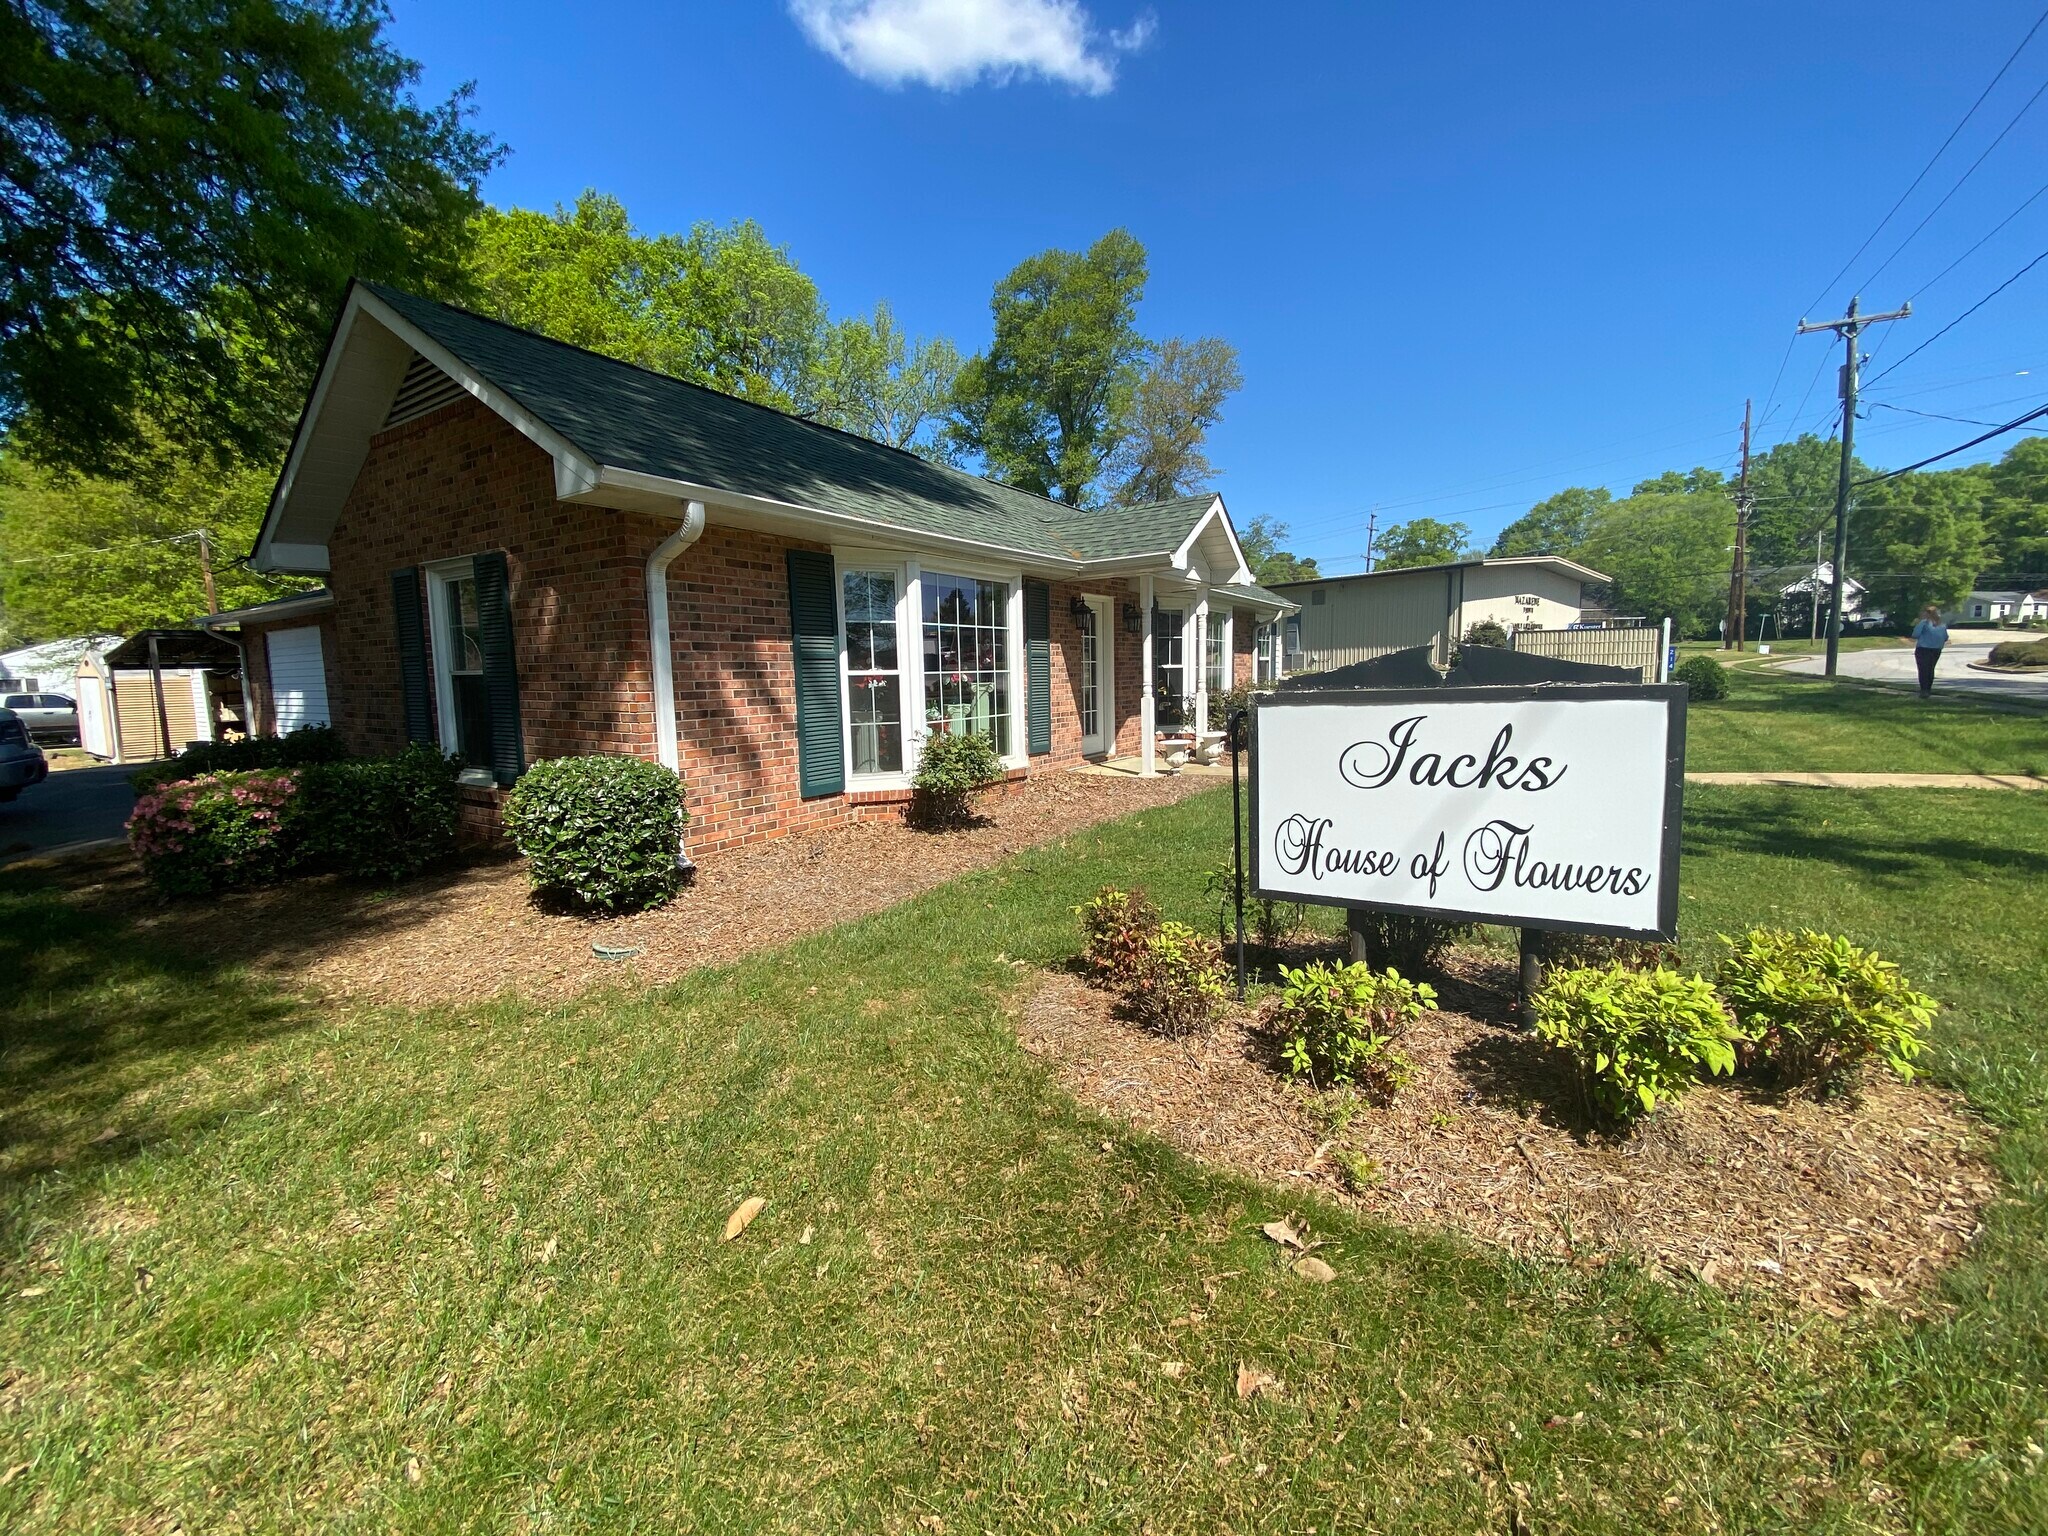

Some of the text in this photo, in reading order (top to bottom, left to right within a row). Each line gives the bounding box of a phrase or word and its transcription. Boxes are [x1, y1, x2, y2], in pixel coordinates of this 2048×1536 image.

[1338, 715, 1568, 792] Jacks
[1274, 813, 1651, 899] House of Flowers
